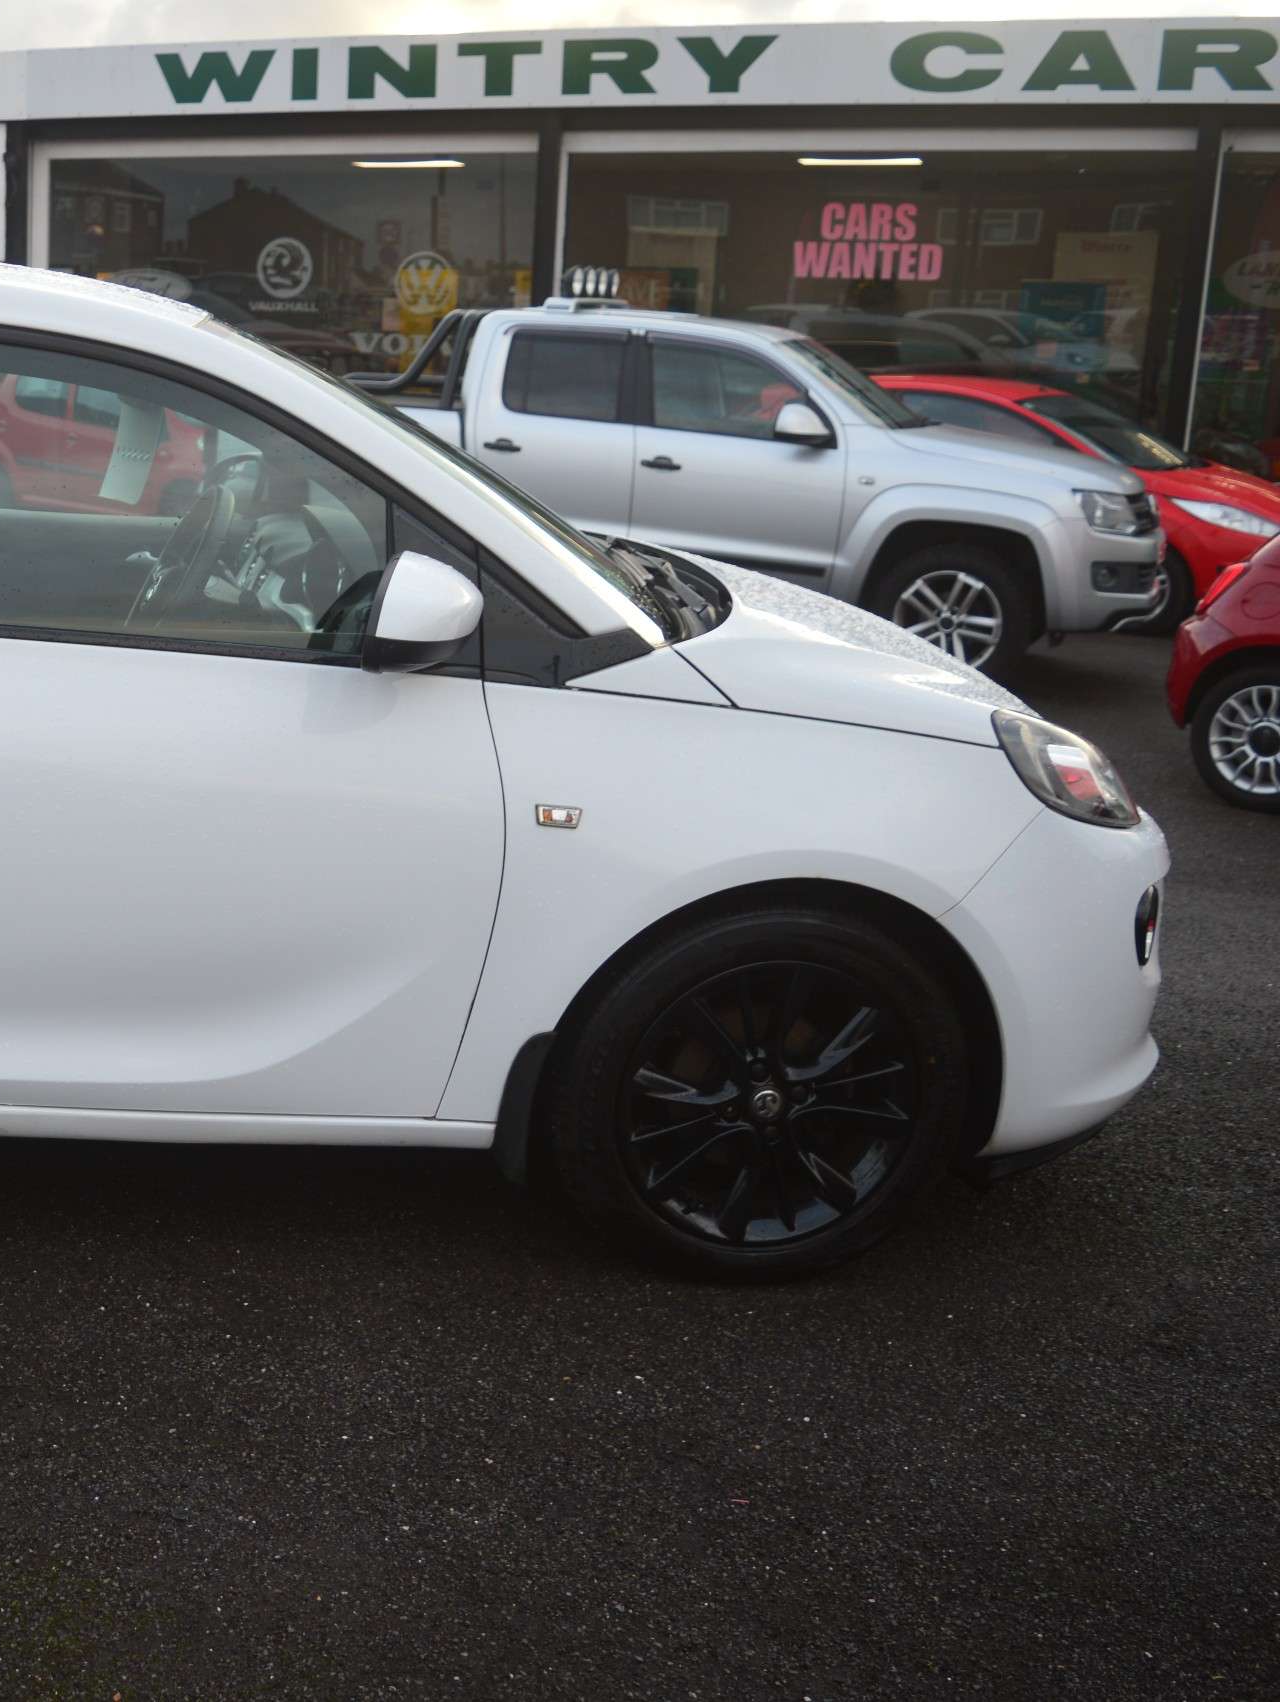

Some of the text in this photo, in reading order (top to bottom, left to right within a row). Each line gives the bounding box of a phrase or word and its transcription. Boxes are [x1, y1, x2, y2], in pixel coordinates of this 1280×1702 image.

[154, 28, 1279, 104] WINTRY CAR
[821, 202, 918, 242] CARS
[794, 241, 944, 281] WANTED
[248, 301, 319, 312] VAUXHALL
